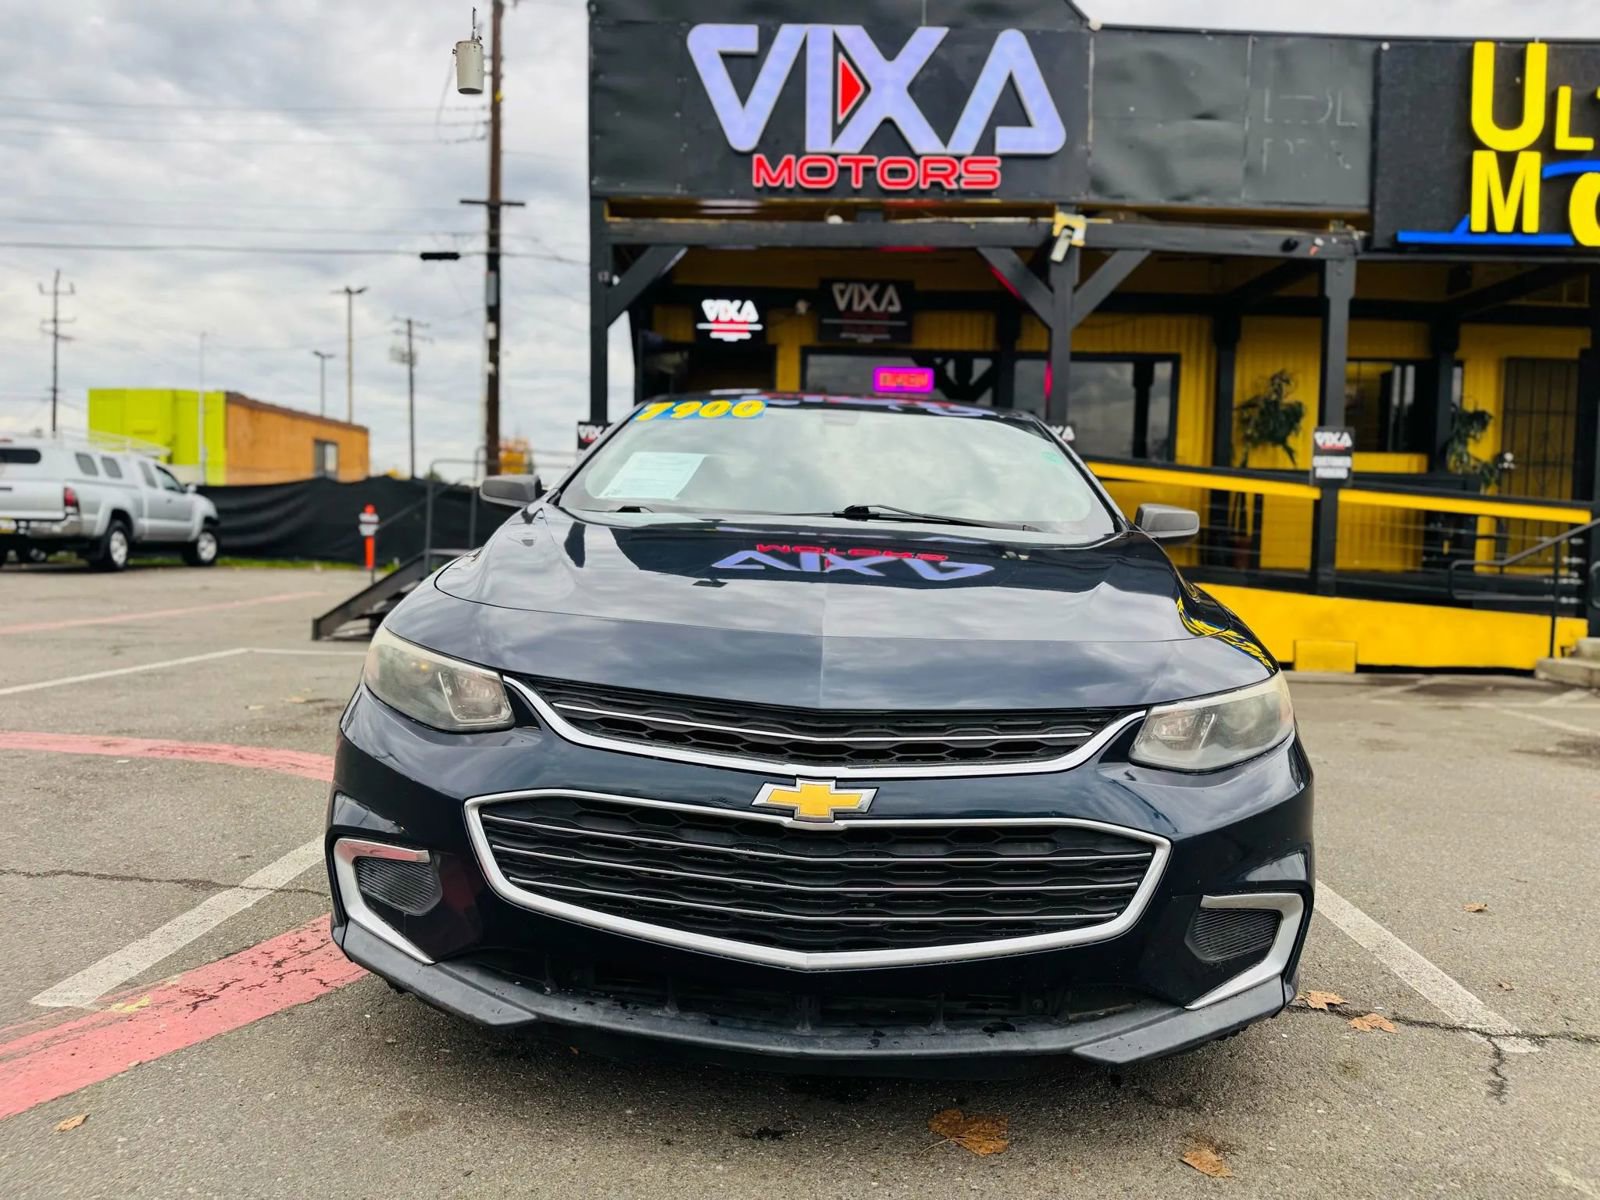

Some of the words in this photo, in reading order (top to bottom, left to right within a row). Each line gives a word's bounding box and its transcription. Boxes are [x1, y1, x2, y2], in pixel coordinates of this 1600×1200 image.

[687, 23, 1067, 155] VIXA
[1471, 41, 1600, 151] UL
[752, 154, 1001, 191] MOTORS
[701, 299, 759, 323] VIXA
[832, 282, 902, 312] VIXA
